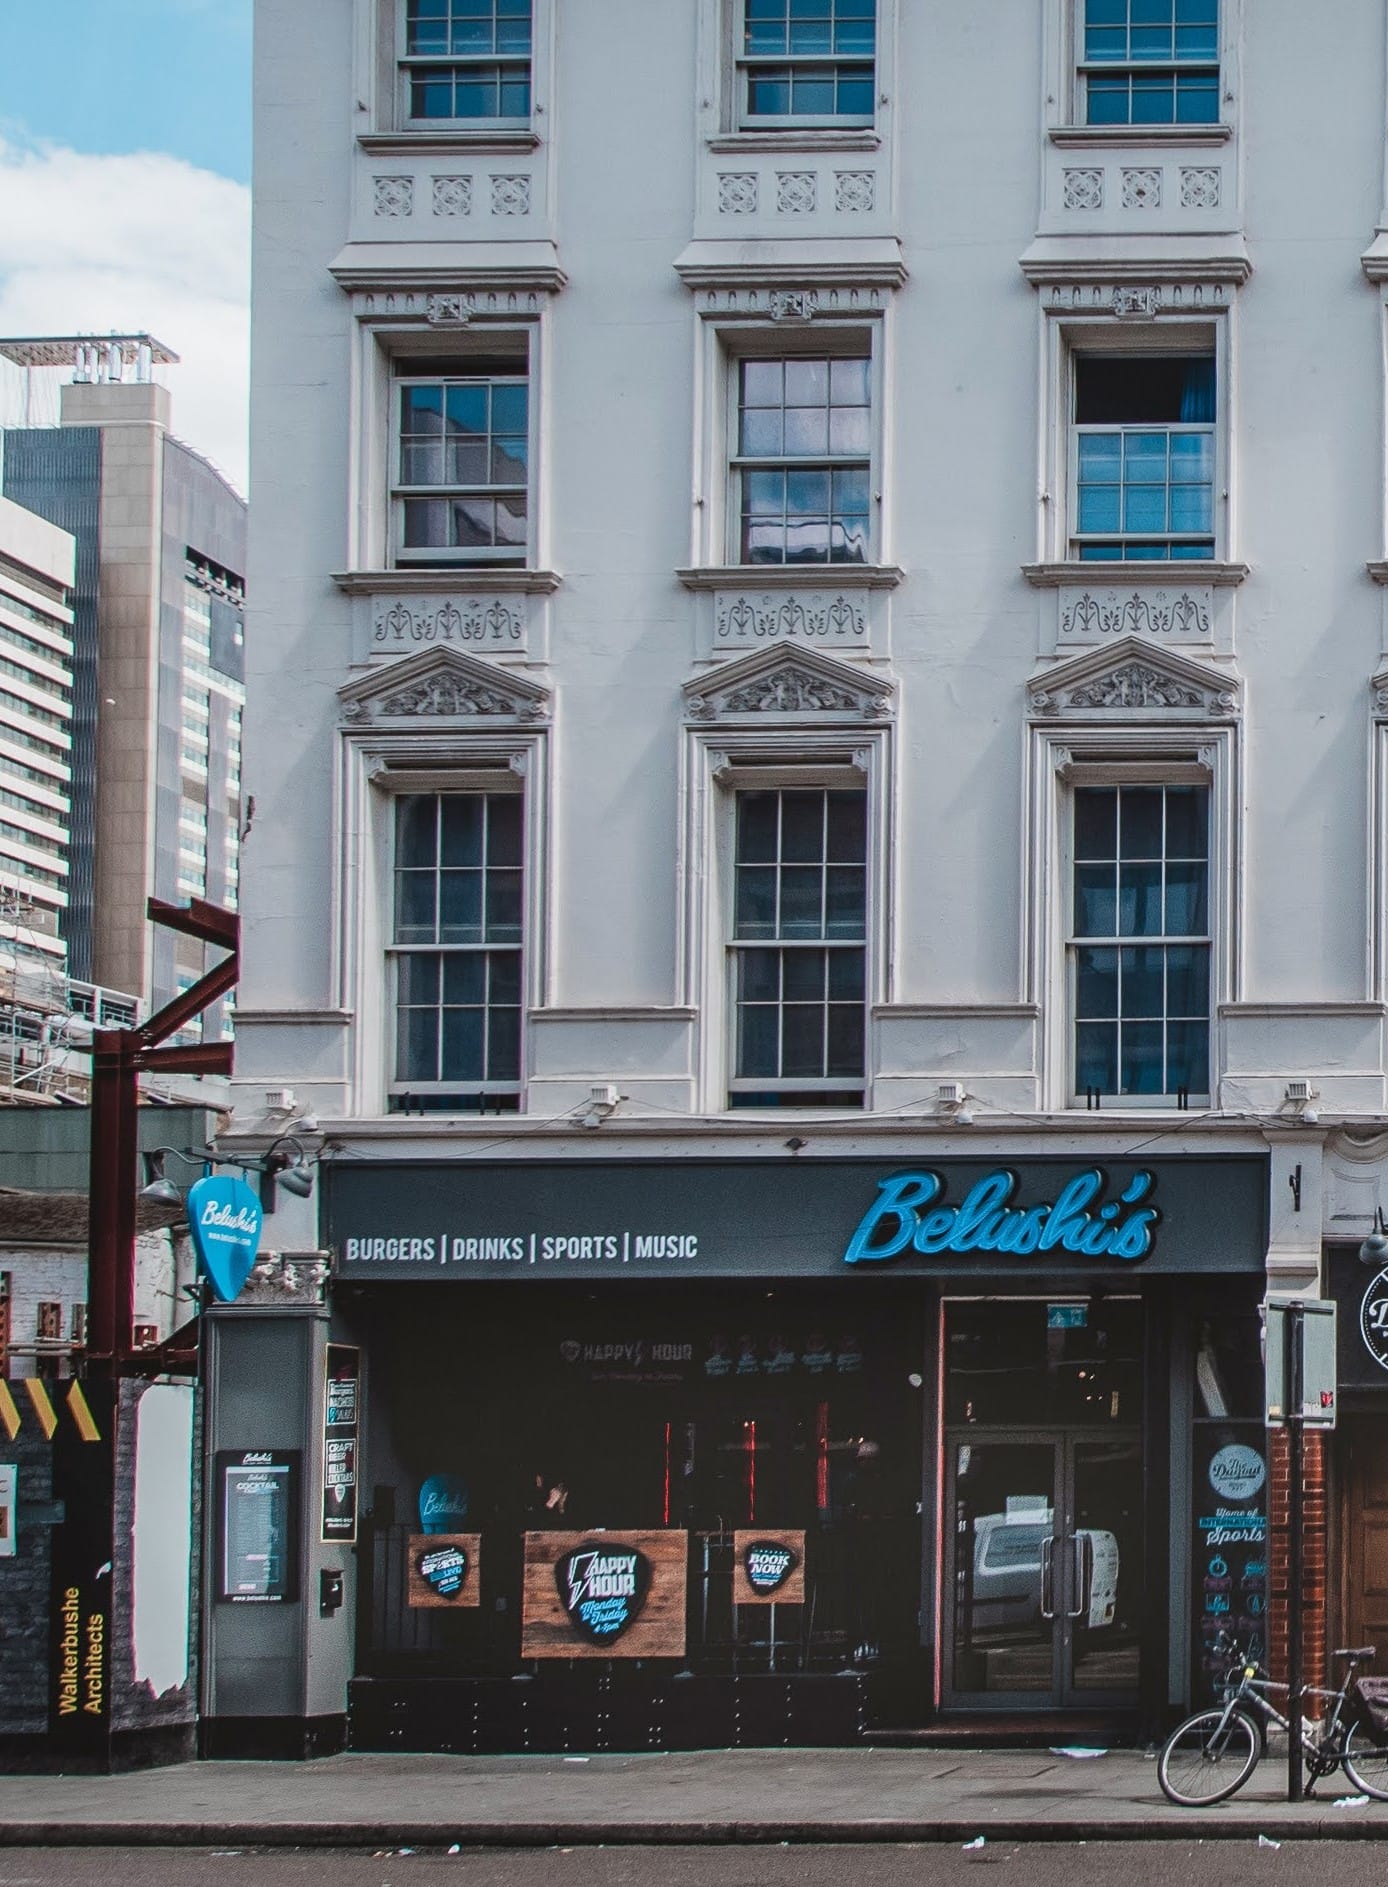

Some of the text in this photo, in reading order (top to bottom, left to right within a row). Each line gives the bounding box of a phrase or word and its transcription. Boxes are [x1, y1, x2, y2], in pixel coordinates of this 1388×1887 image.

[200, 1200, 259, 1234] Belushi's
[844, 1168, 1158, 1263] Belushi's
[346, 1235, 698, 1261] BURGERS DRINKS SPORTS MUSIC
[1206, 1526, 1266, 1546] Sports
[590, 1554, 637, 1575] HAPPY
[748, 1553, 790, 1566] BOOK
[750, 1563, 785, 1575] NOW
[589, 1574, 636, 1598] HOUR
[580, 1597, 626, 1612] Monday
[590, 1608, 629, 1625] Friday
[59, 1586, 80, 1715] Walkerbushe
[83, 1613, 104, 1714] Architects
